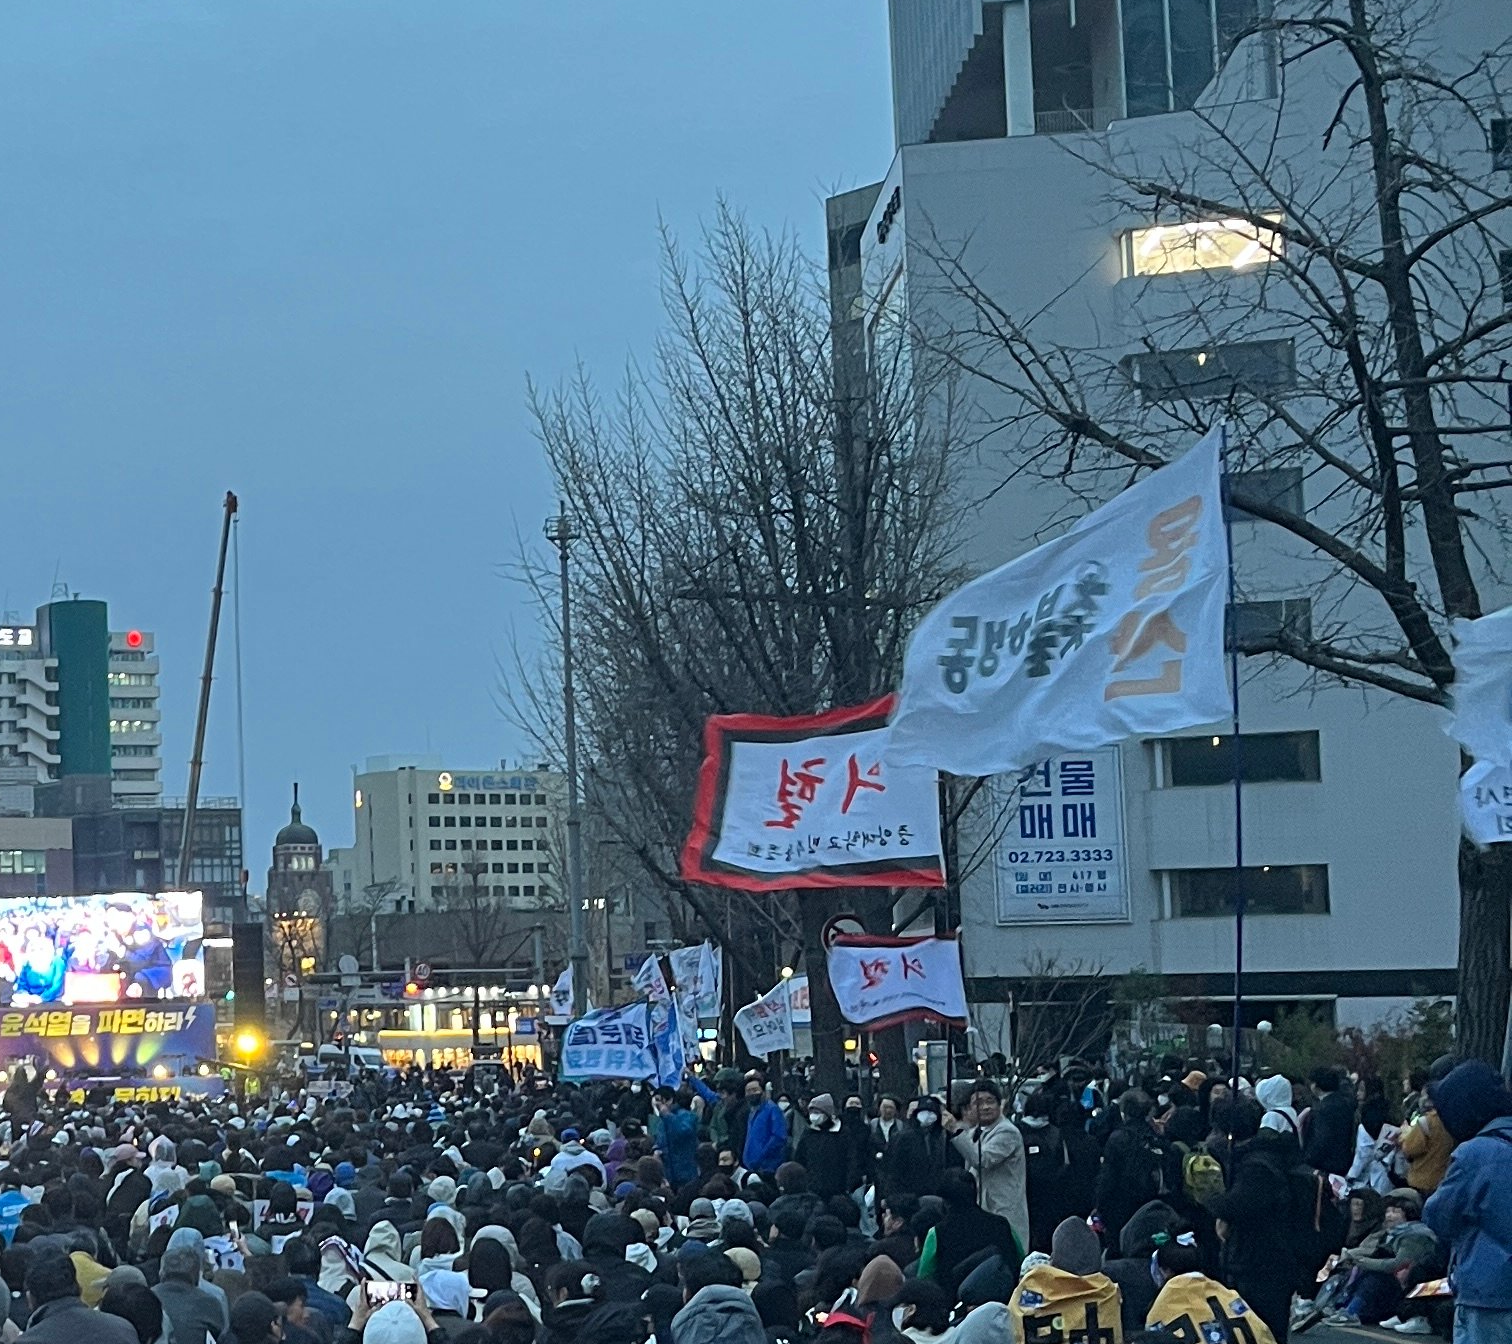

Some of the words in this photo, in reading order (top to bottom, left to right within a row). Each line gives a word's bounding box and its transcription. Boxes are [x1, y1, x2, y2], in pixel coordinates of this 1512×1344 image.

[1020, 803, 1096, 839] 매매
[1008, 849, 1113, 864] 02.723.3333
[0, 1010, 91, 1037] 윤석열을
[96, 1008, 184, 1035] 파면하라
